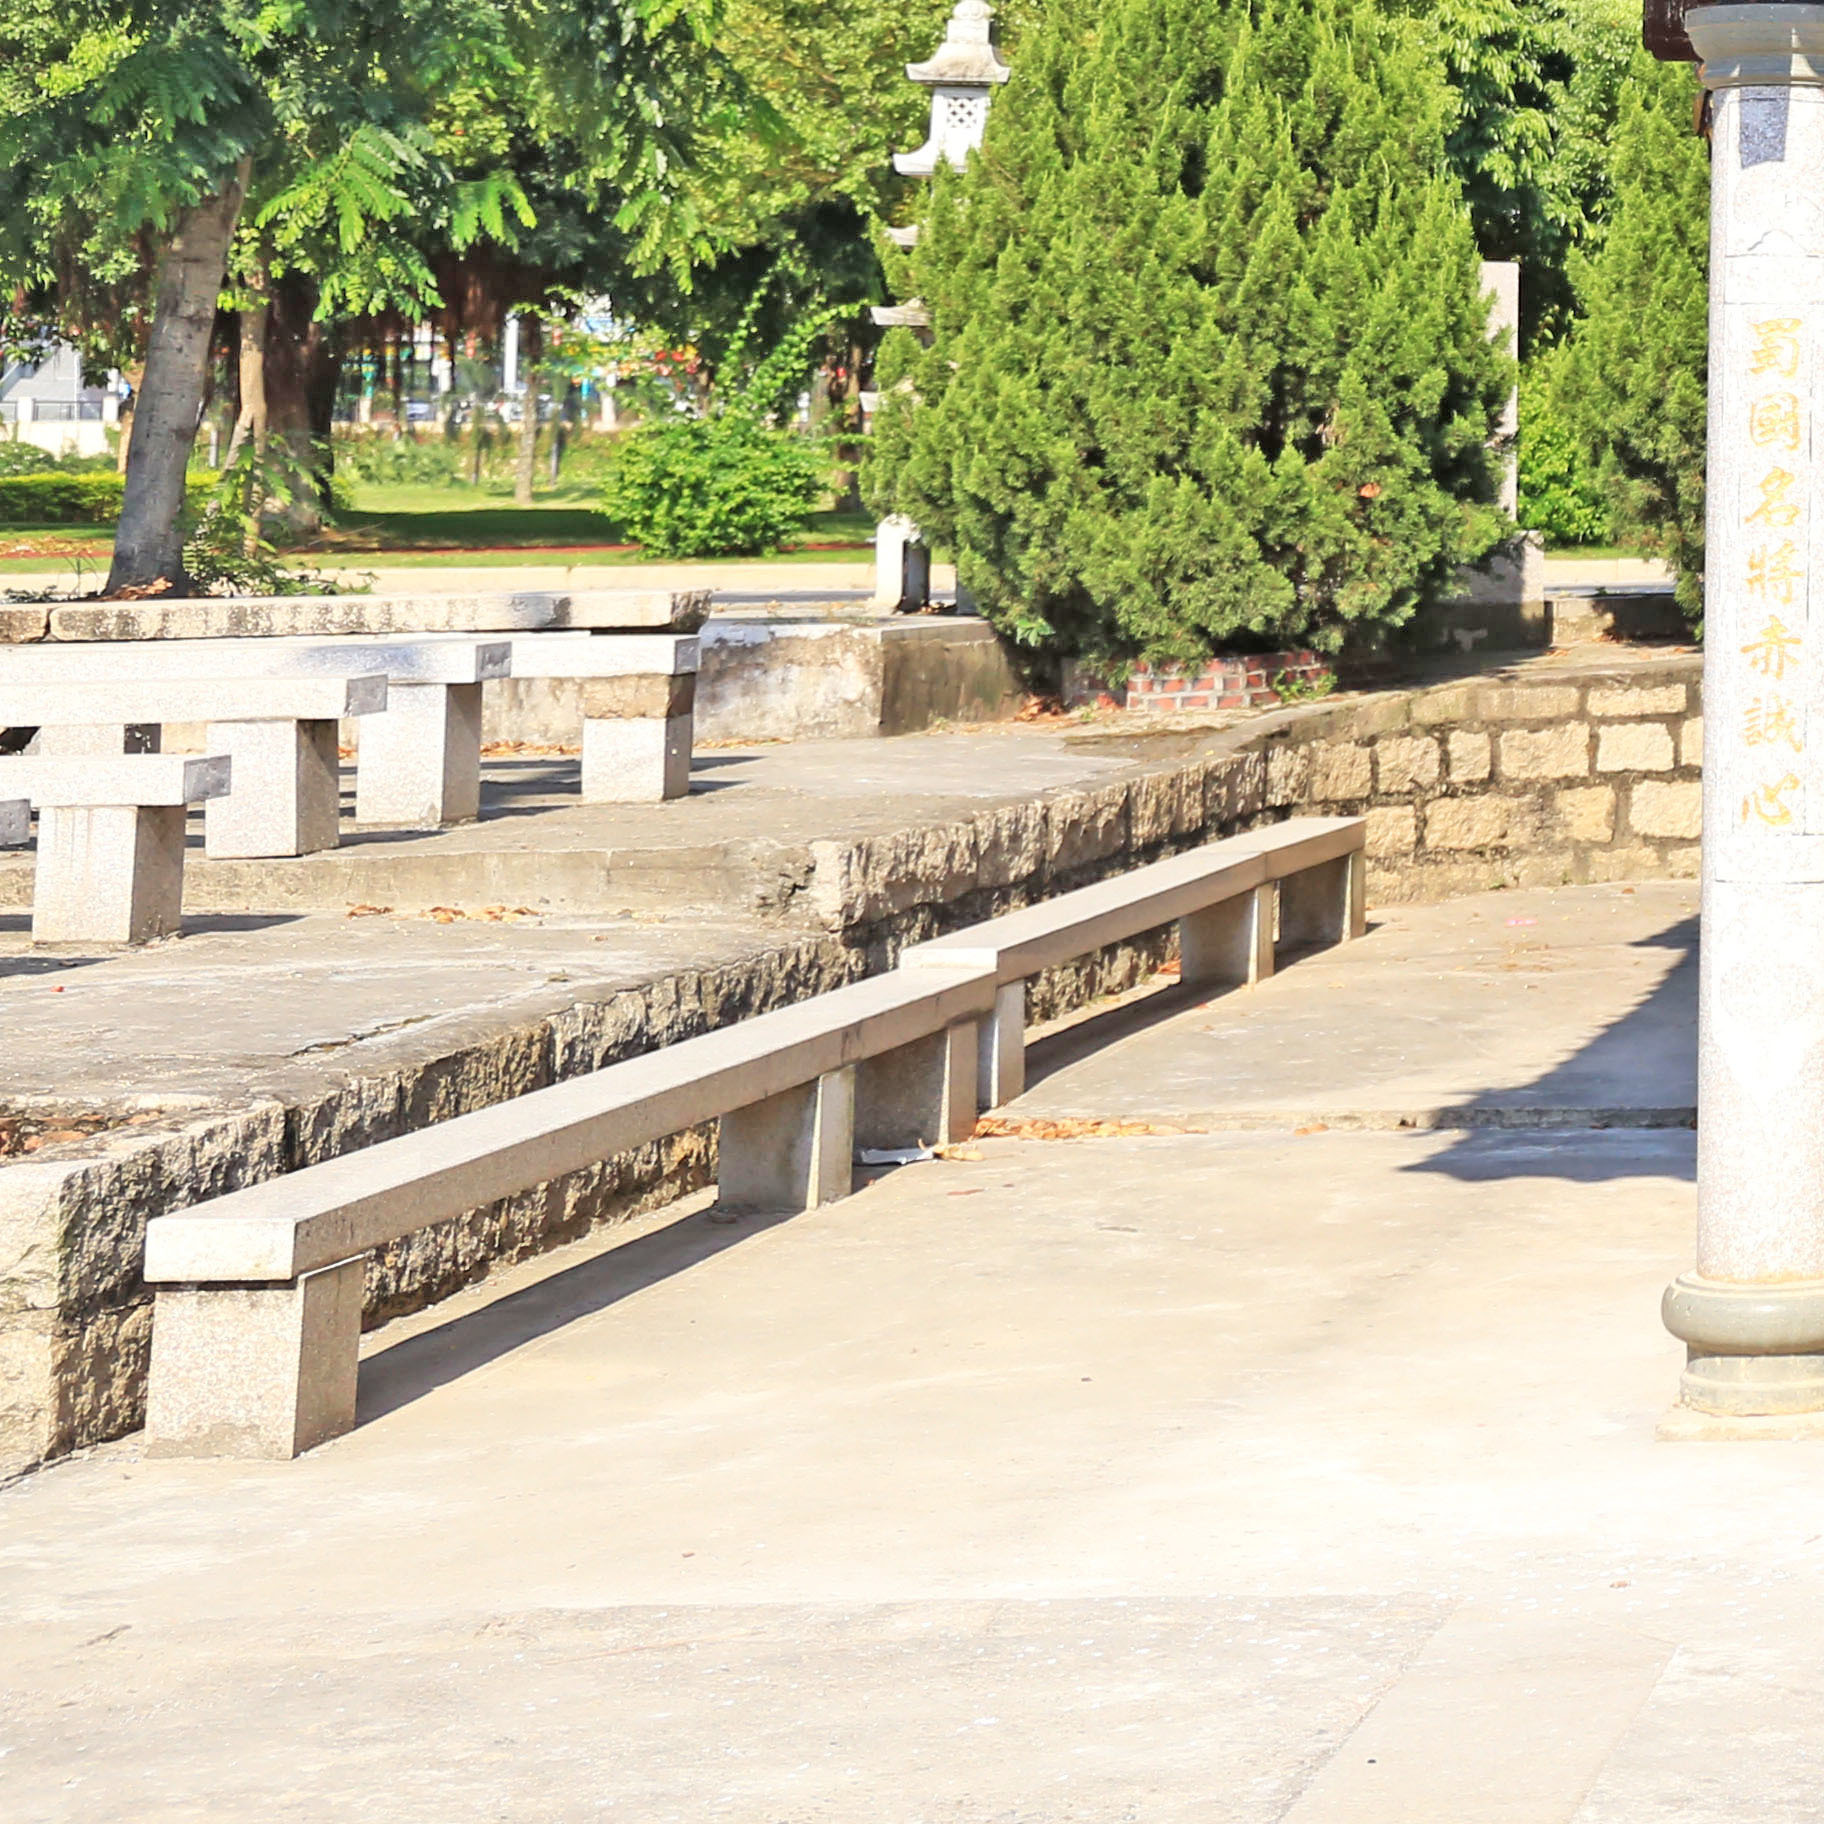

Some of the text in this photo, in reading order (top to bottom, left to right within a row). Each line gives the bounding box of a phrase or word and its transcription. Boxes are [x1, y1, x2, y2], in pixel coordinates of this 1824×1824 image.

[1739, 317, 1805, 827] 蜀國名將赤誠心
